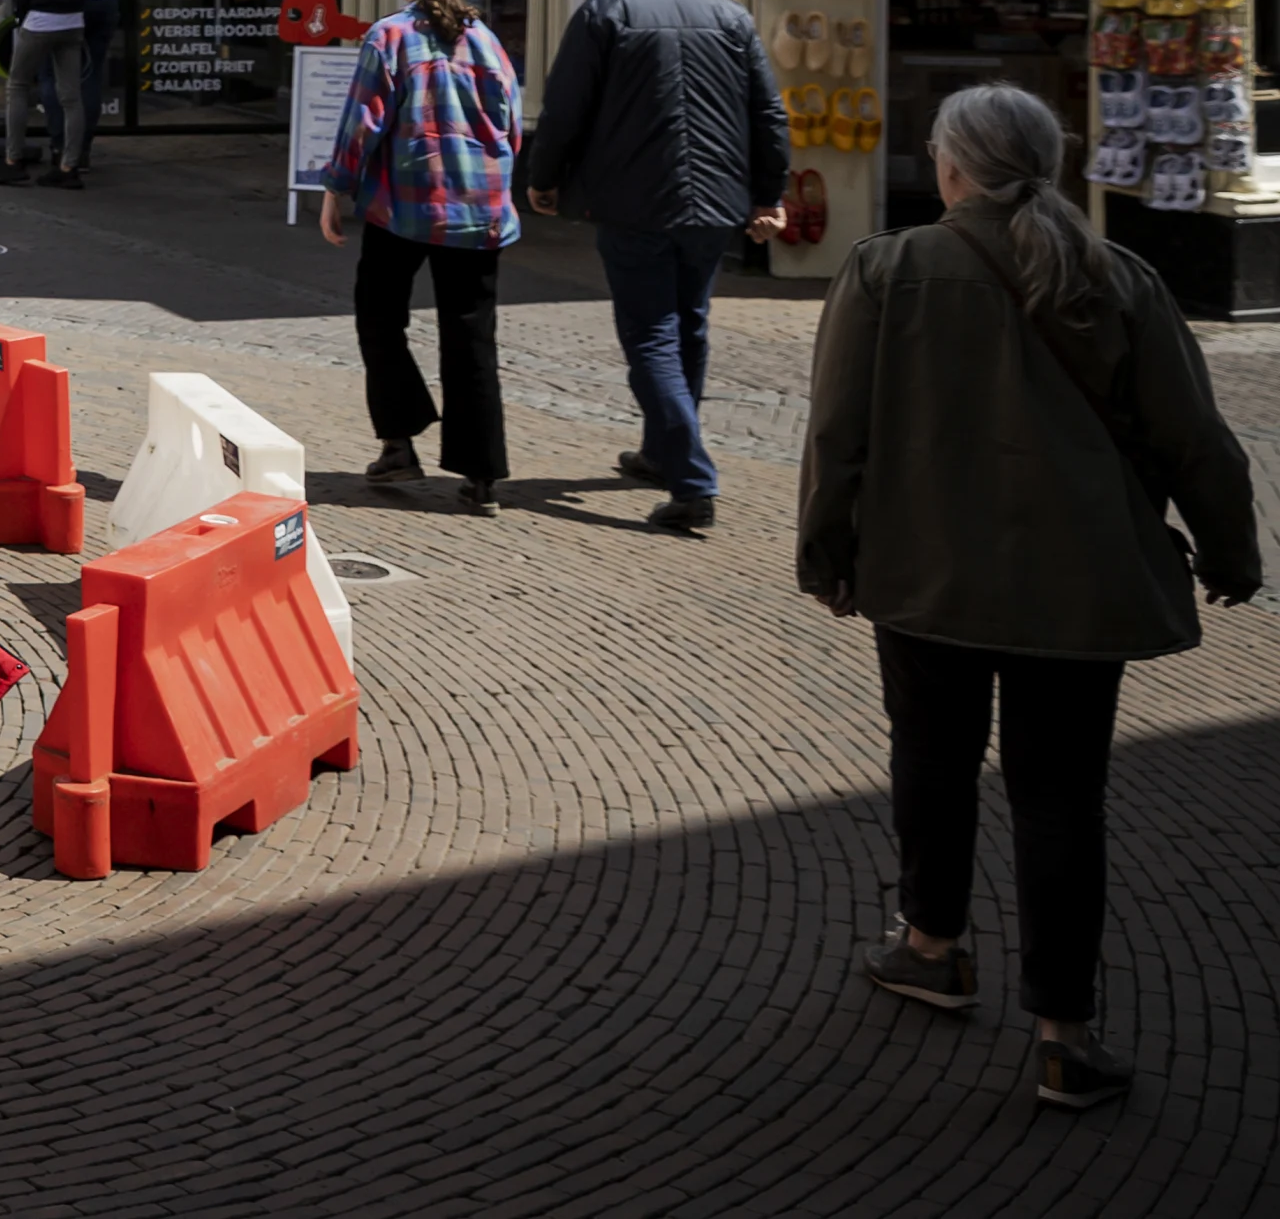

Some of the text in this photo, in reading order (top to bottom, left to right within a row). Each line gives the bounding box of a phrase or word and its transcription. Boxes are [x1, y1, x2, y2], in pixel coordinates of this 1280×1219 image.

[153, 7, 295, 20] GEPOFTE AARDAPPL
[153, 24, 201, 37] VERSE
[153, 42, 217, 56] FALAFEL
[153, 60, 255, 74] (ZOETE) FRIET
[153, 79, 222, 91] SALADES
